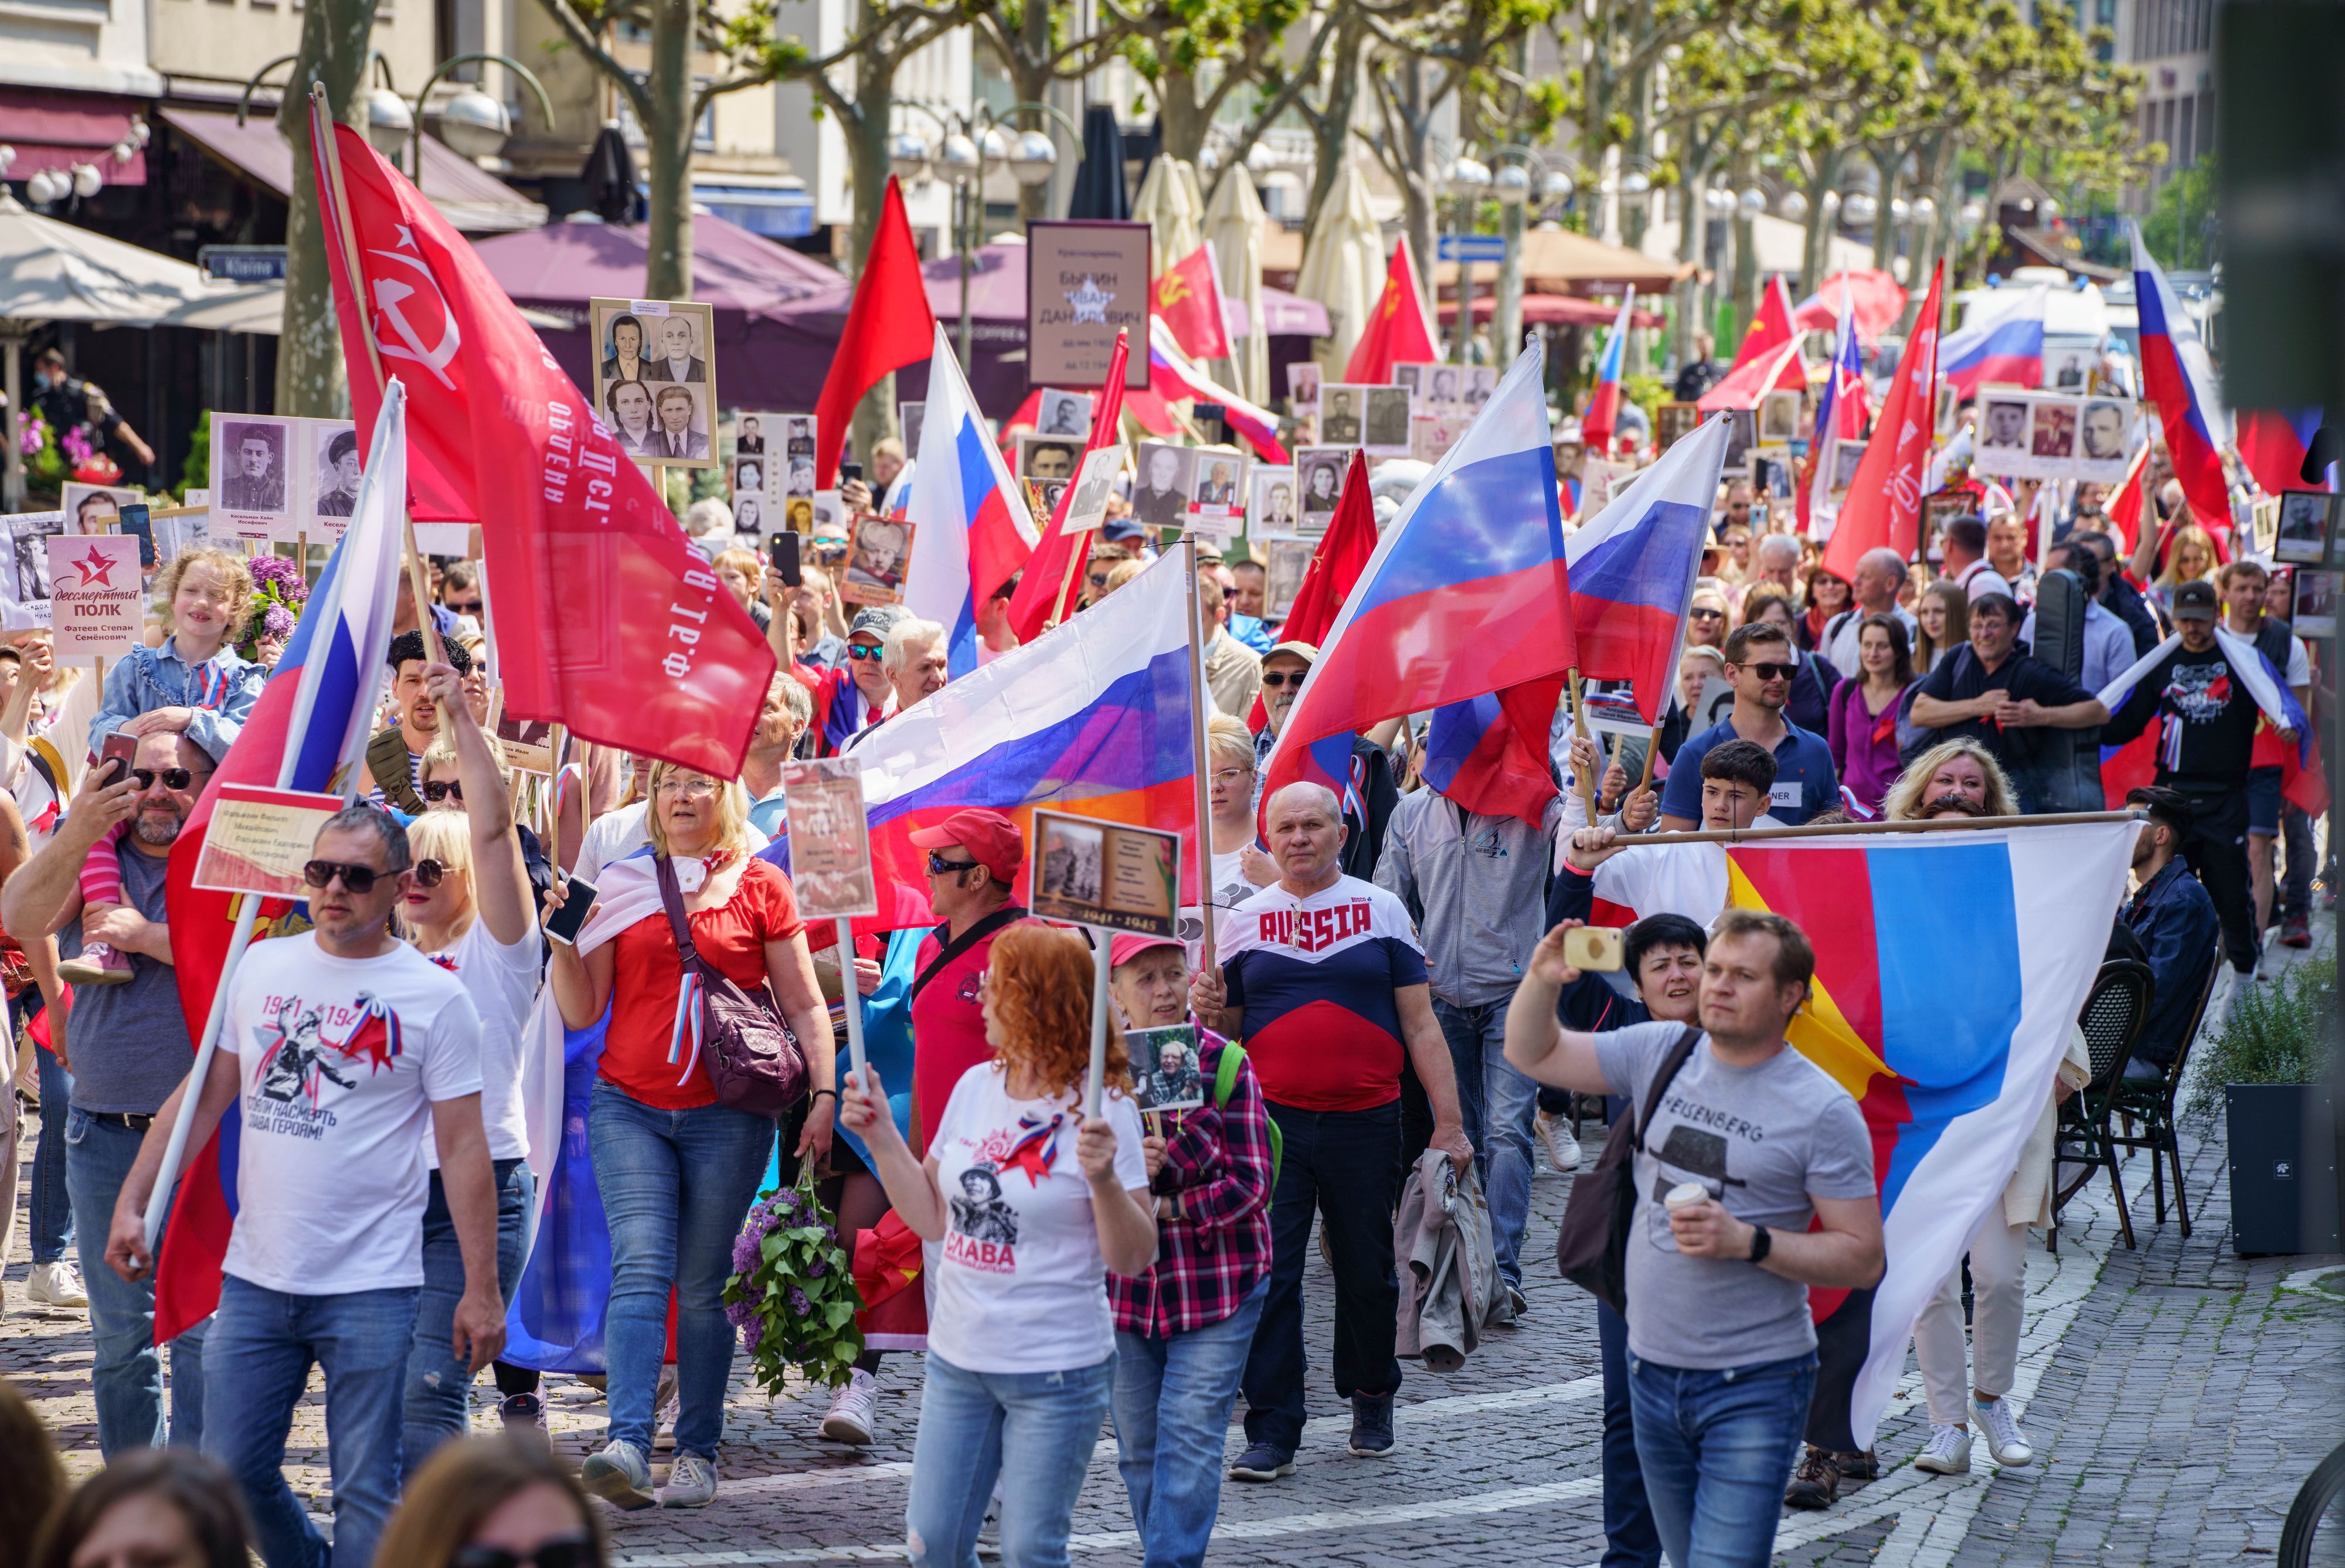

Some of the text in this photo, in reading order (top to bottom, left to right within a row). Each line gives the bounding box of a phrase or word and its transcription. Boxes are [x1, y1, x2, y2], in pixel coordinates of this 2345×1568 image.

[225, 256, 274, 276] Kleine
[54, 576, 140, 603] бессмертный
[74, 604, 122, 616] ПОЛК
[1769, 792, 1790, 800] NER
[1084, 909, 1113, 925] 1941
[1124, 916, 1157, 932] 1945
[1259, 903, 1371, 953] RUSSIA
[263, 995, 303, 1019] 191
[271, 1117, 325, 1141] ГЕРОЯМ!
[946, 1230, 1016, 1266] СЛАВА
